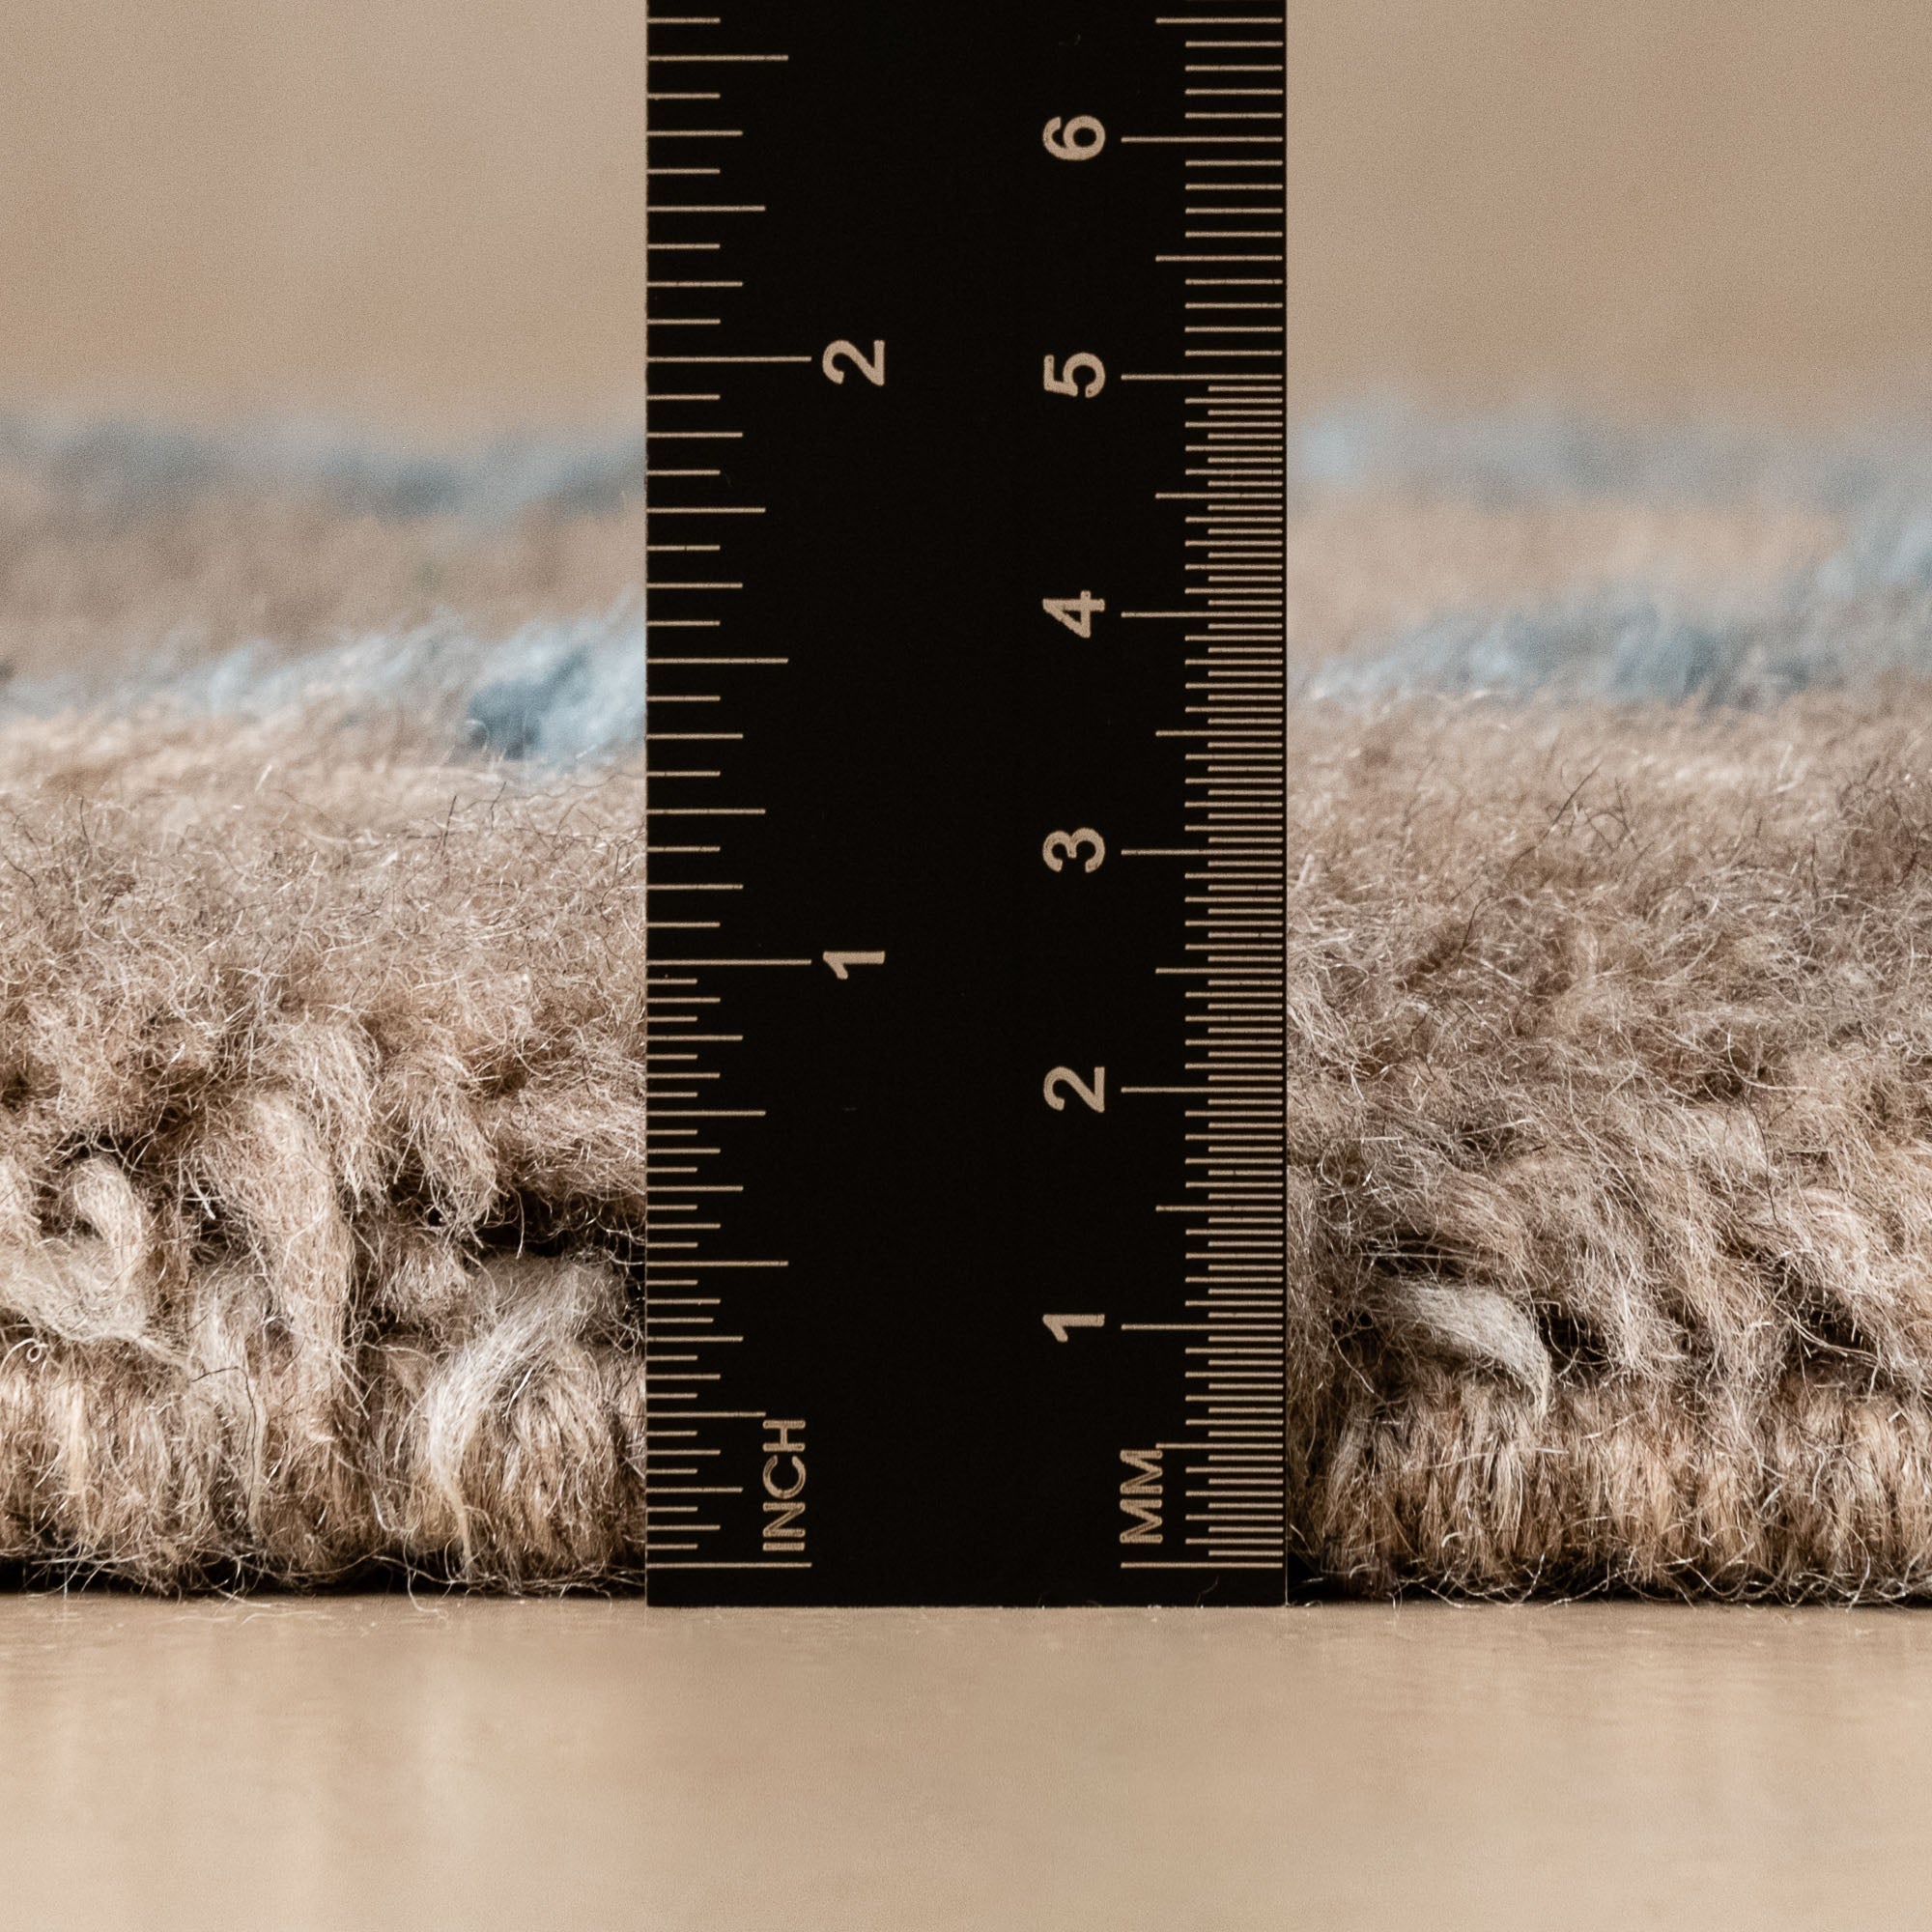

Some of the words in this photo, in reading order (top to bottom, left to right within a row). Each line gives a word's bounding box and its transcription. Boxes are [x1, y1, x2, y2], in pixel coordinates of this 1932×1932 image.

[1043, 116, 1105, 160] 6
[822, 340, 885, 385] 2
[1043, 353, 1105, 398] 5
[1042, 590, 1105, 638] 4
[1042, 828, 1105, 872] 3
[823, 951, 885, 980] 1
[1043, 1066, 1105, 1113] 2
[1042, 1314, 1105, 1342] 1
[762, 1419, 807, 1552] INCH
[1119, 1449, 1164, 1545] MM
